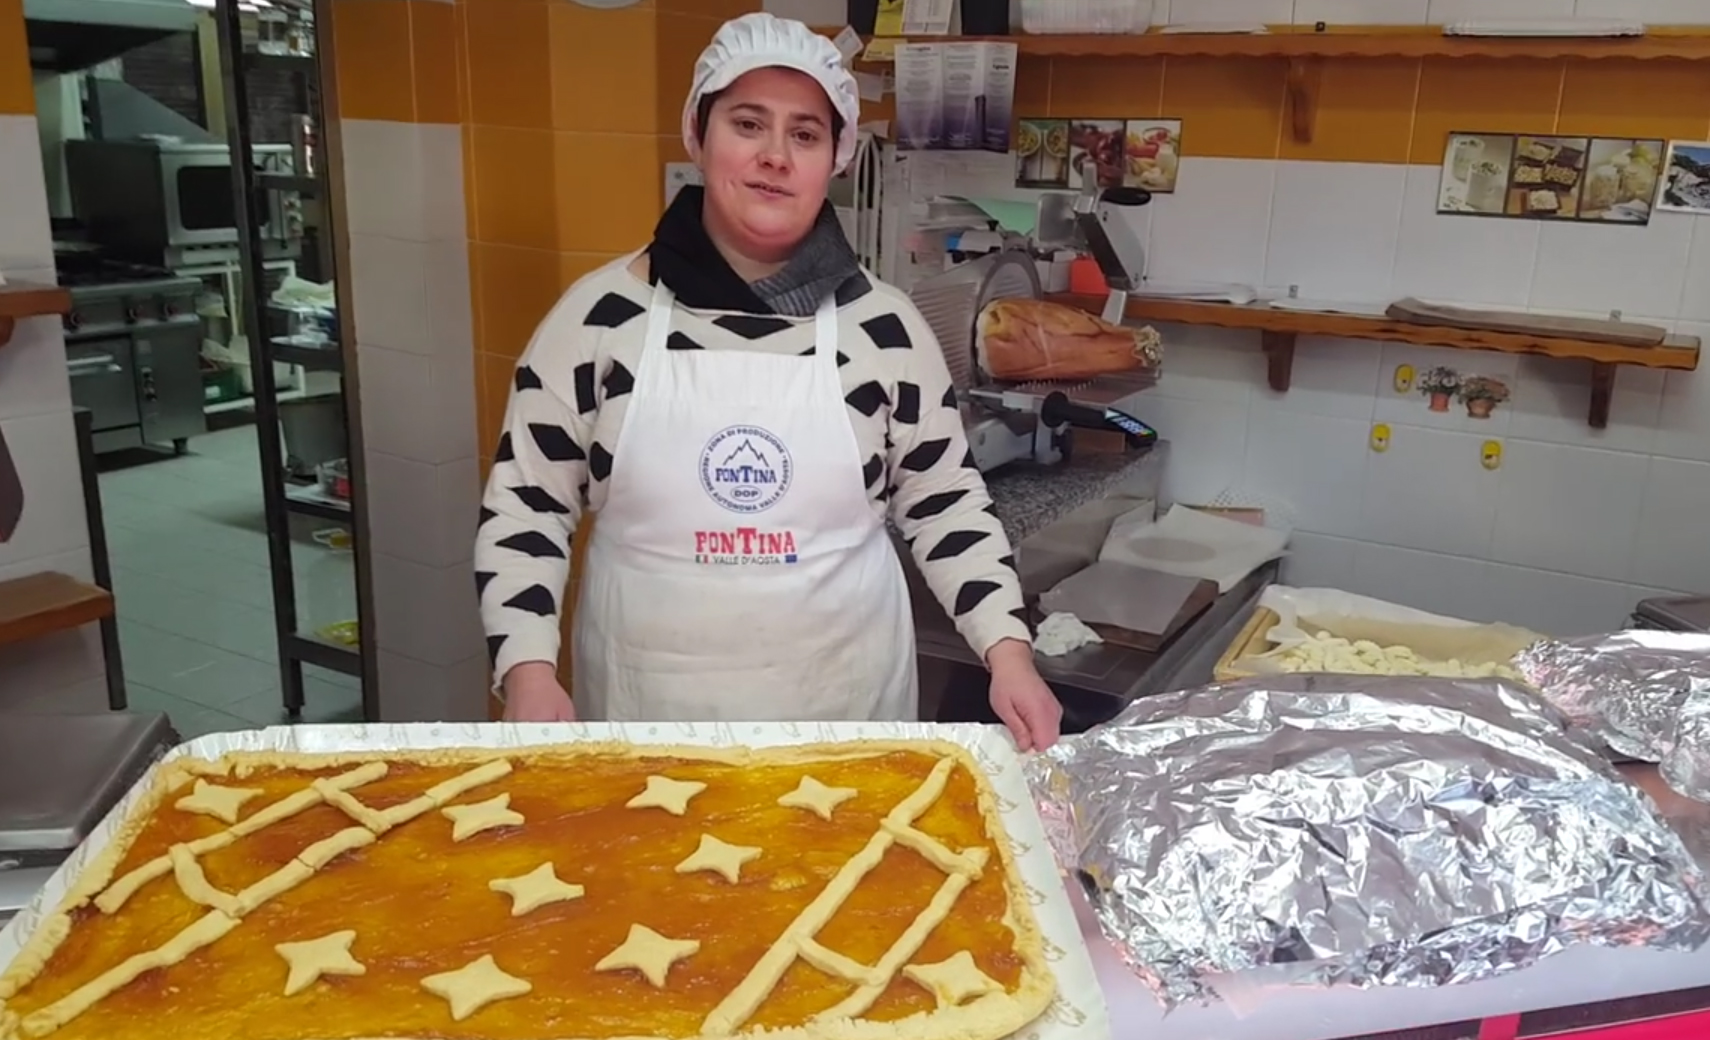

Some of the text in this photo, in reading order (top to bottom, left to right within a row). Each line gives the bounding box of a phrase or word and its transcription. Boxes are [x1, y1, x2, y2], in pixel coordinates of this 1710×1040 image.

[708, 428, 784, 454] ZONA DI PRODUZIONE
[702, 457, 714, 491] REGIONE
[712, 492, 758, 511] AUTONOMA
[759, 491, 780, 508] VALLE
[715, 465, 777, 483] FONTINA
[734, 489, 758, 498] DOP
[694, 527, 796, 554] FONTINA
[713, 555, 780, 565] VALLE D'AOSTA
